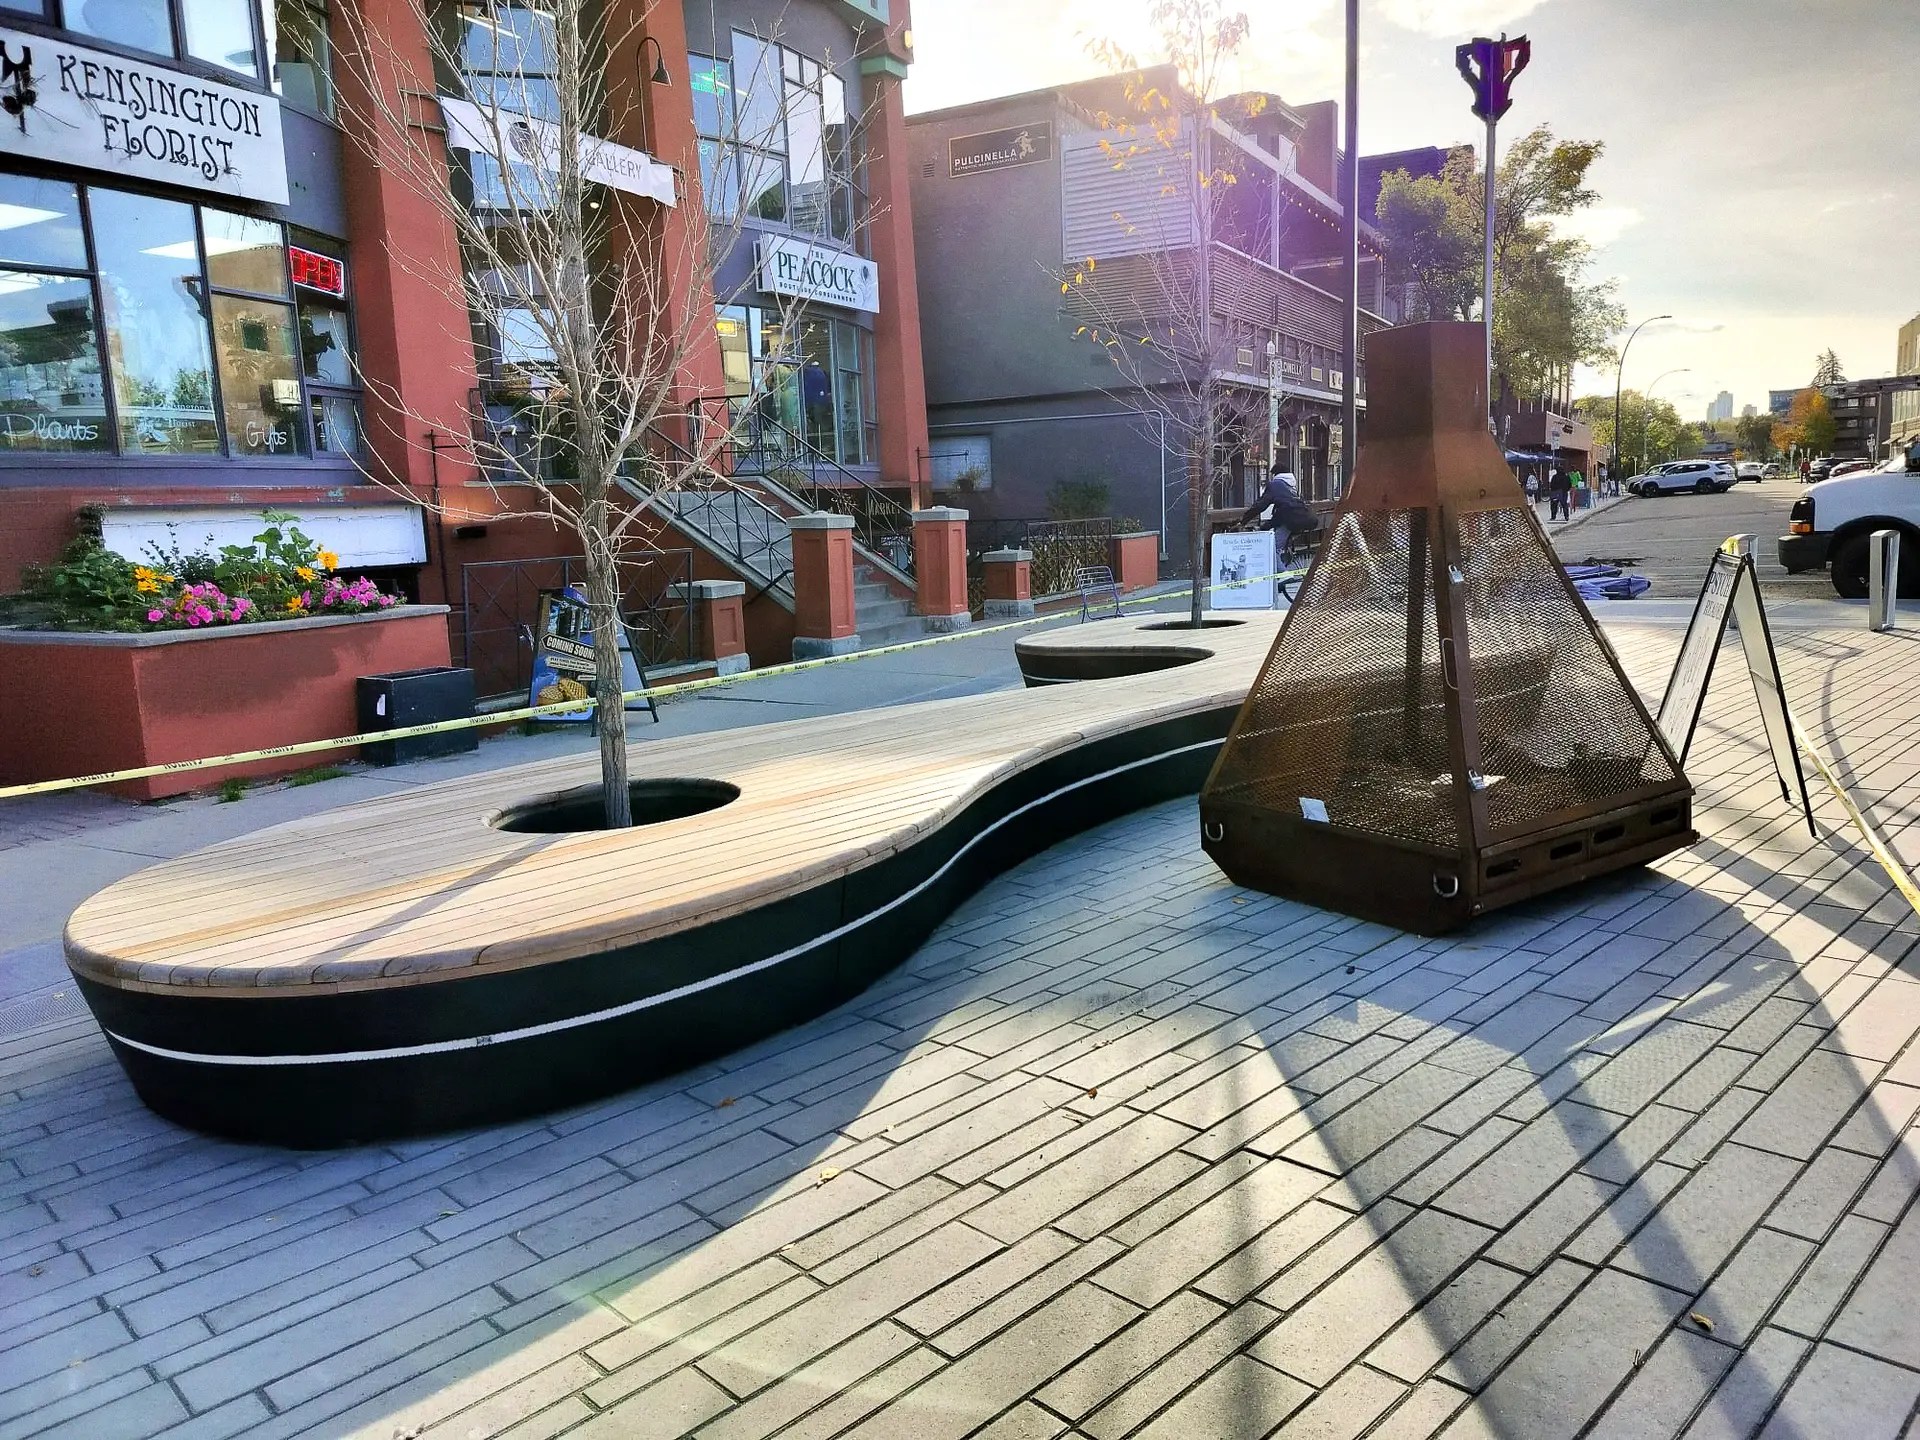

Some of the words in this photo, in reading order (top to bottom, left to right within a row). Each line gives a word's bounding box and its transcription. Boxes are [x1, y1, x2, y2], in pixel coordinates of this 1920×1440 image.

[57, 54, 262, 137] KENSINGTON
[102, 113, 233, 181] FLORIST
[954, 148, 1018, 167] PULCINELLA
[291, 247, 343, 293] OPEN
[811, 250, 825, 259] THE
[776, 250, 857, 295] PEACOCK
[0, 413, 99, 447] Plants
[246, 421, 287, 453] Gifts
[866, 499, 901, 516] MARKET
[546, 636, 574, 654] COMING
